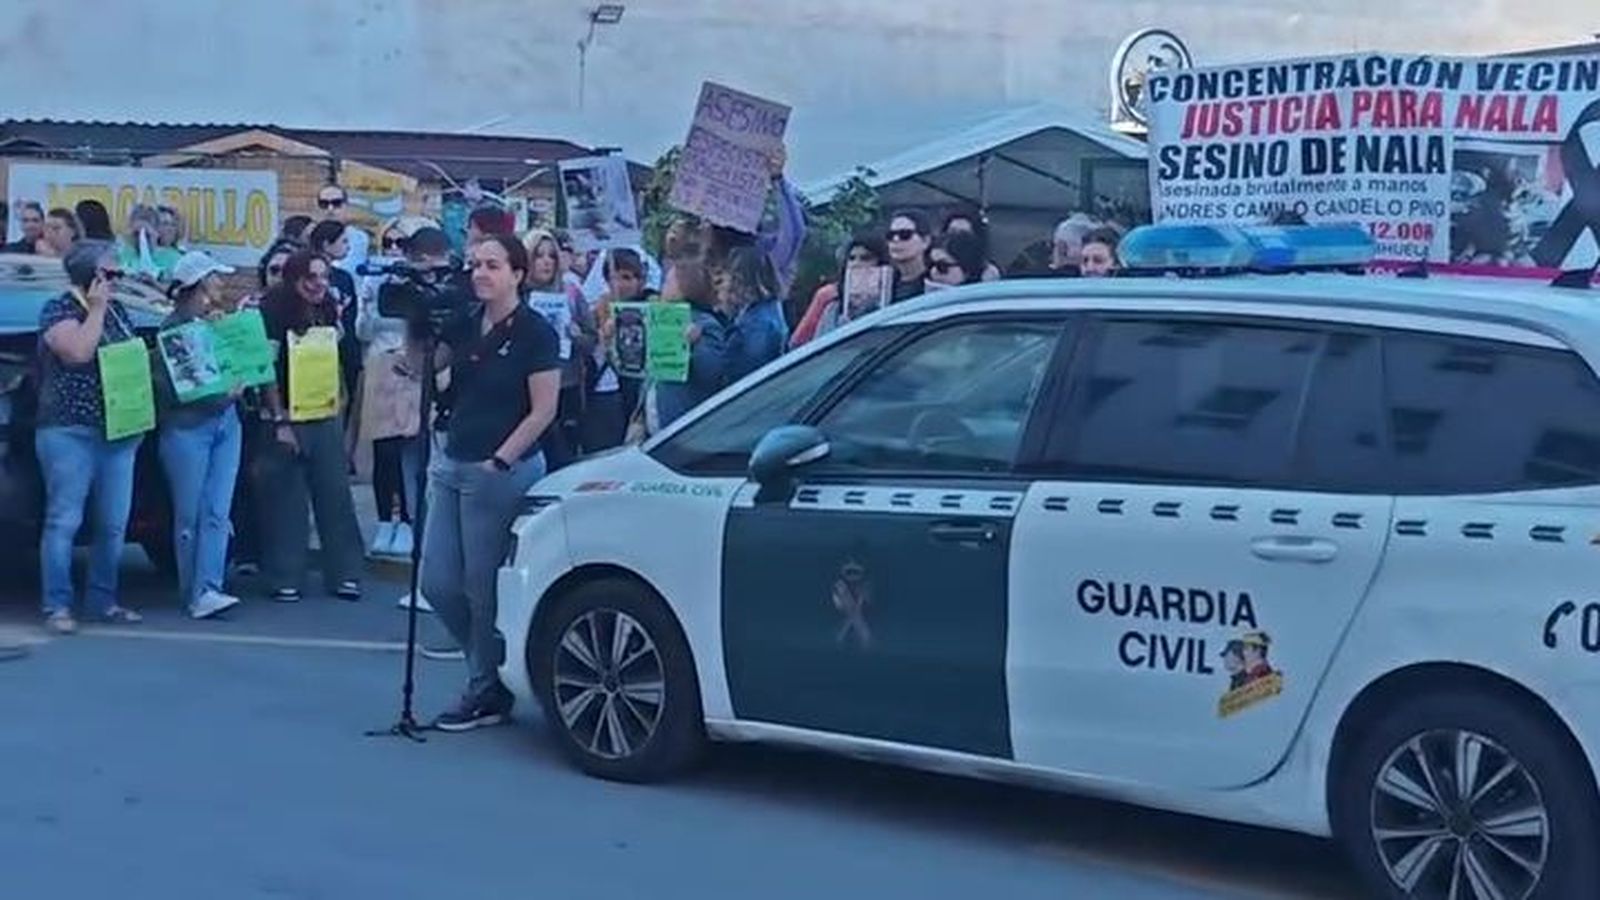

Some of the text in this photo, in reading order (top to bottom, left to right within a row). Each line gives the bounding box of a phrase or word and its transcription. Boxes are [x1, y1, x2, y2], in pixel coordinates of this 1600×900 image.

[1149, 55, 1599, 103] CONCENTRACIÓN VECIN
[1181, 90, 1558, 139] JUSTICIA PARA NALA
[1159, 134, 1446, 180] SESINO DE NALA
[1246, 177, 1347, 195] brutalmente
[1368, 178, 1428, 193] manos
[1315, 198, 1402, 216] CANDELO
[48, 184, 271, 248] CDILLO
[1077, 579, 1258, 629] GUARDIA
[1118, 631, 1214, 675] CIVIL
